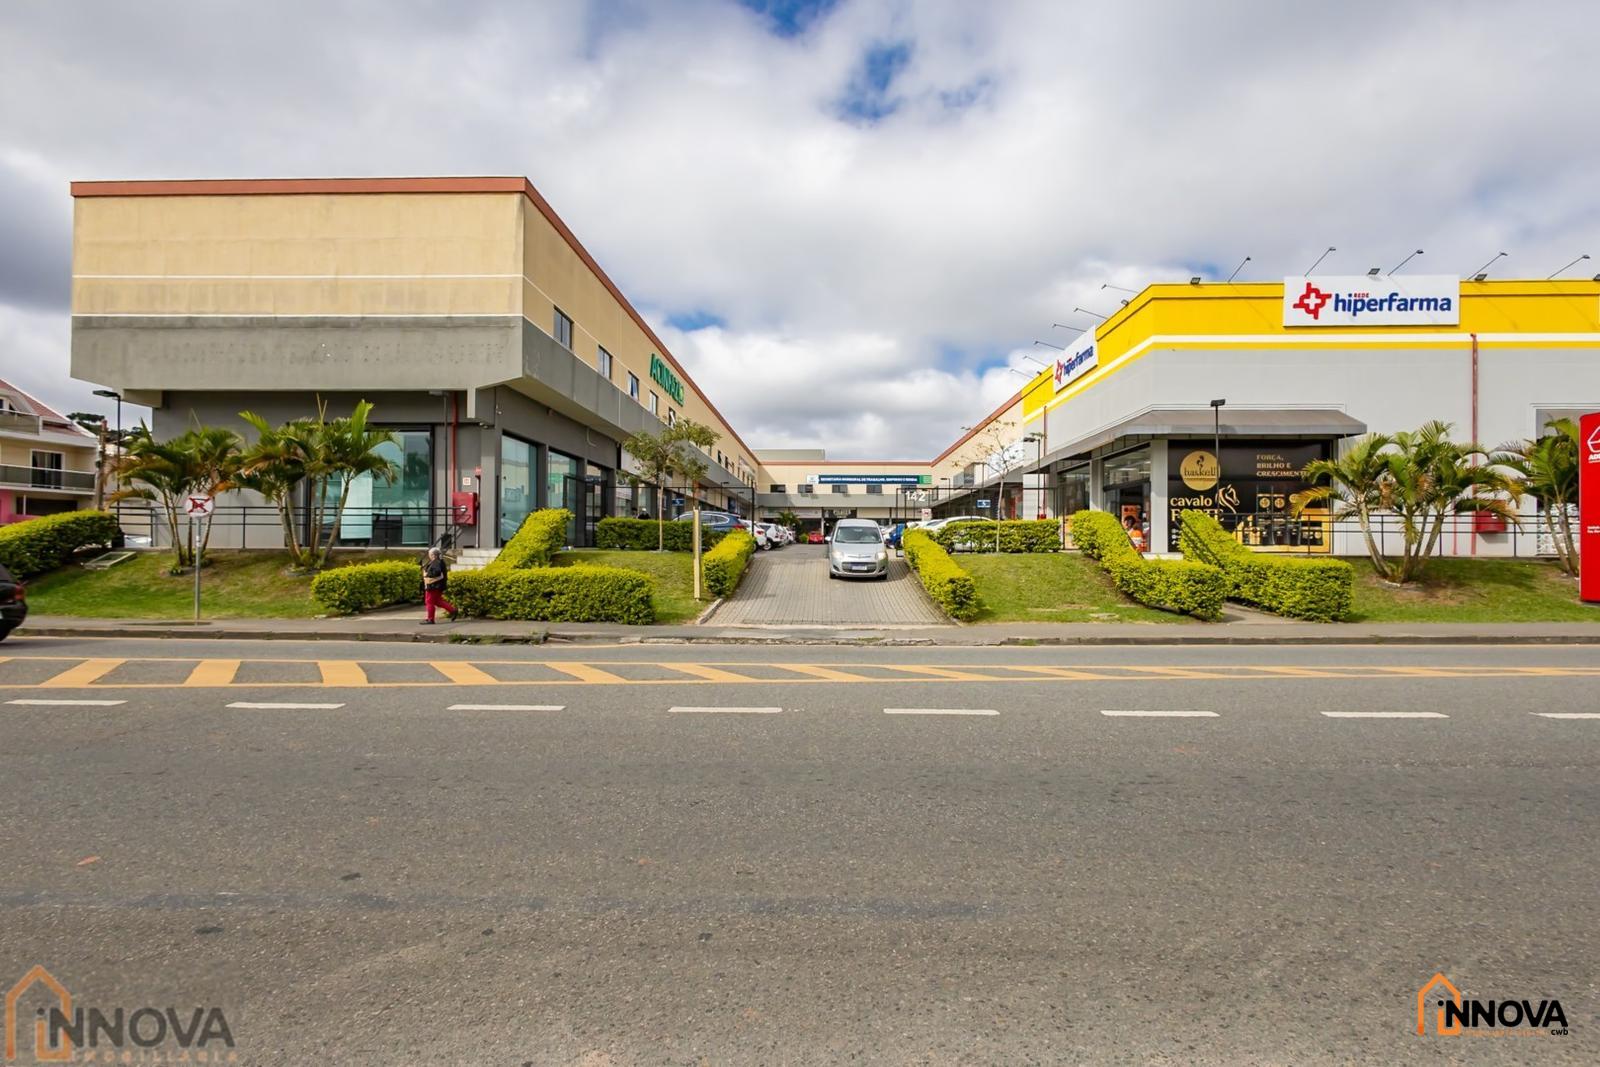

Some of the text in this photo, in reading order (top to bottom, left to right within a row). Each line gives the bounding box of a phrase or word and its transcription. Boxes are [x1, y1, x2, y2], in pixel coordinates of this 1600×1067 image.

[1334, 293, 1452, 316] hiperfarma
[905, 491, 926, 501] 142
[1170, 495, 1212, 506] cavalo
